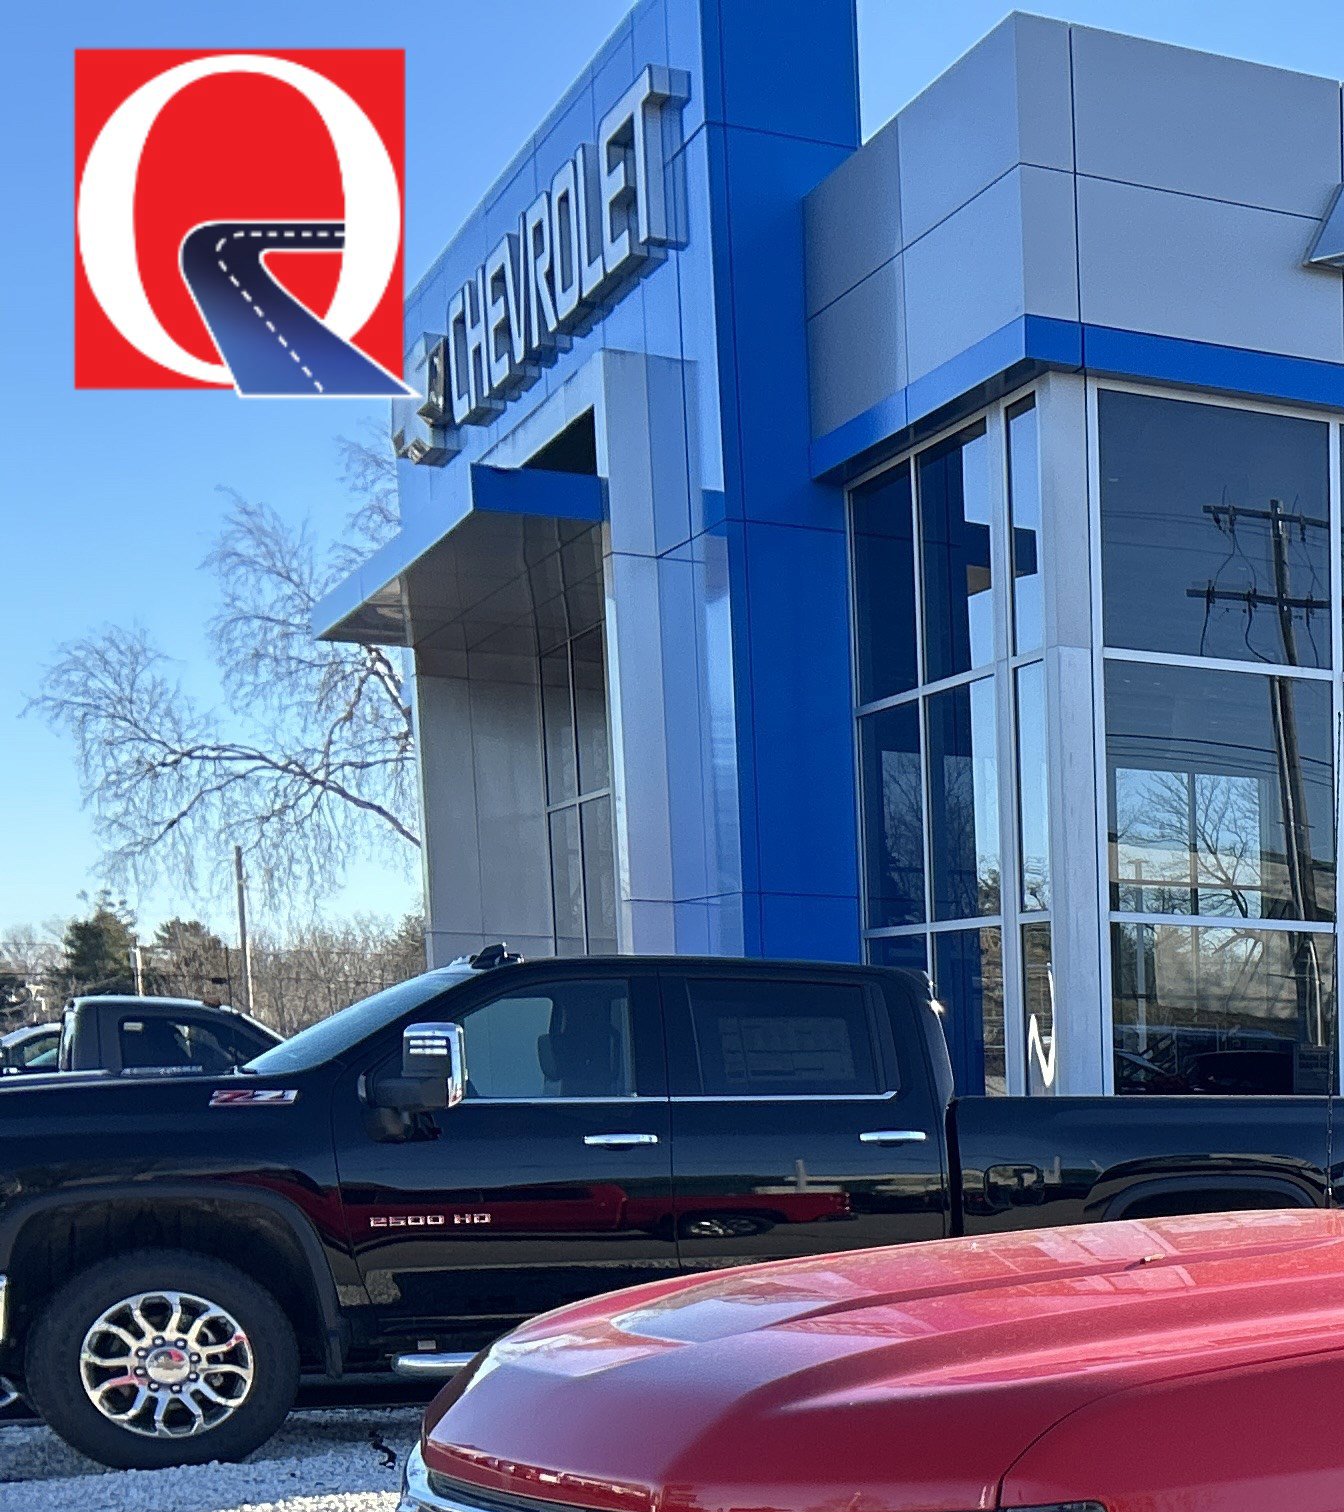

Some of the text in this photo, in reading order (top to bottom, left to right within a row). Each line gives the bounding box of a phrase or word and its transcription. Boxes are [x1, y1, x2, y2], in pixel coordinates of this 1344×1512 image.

[447, 64, 688, 425] CHEVROLET
[209, 1089, 298, 1106] Z71
[370, 1213, 491, 1227] 2500 HD
